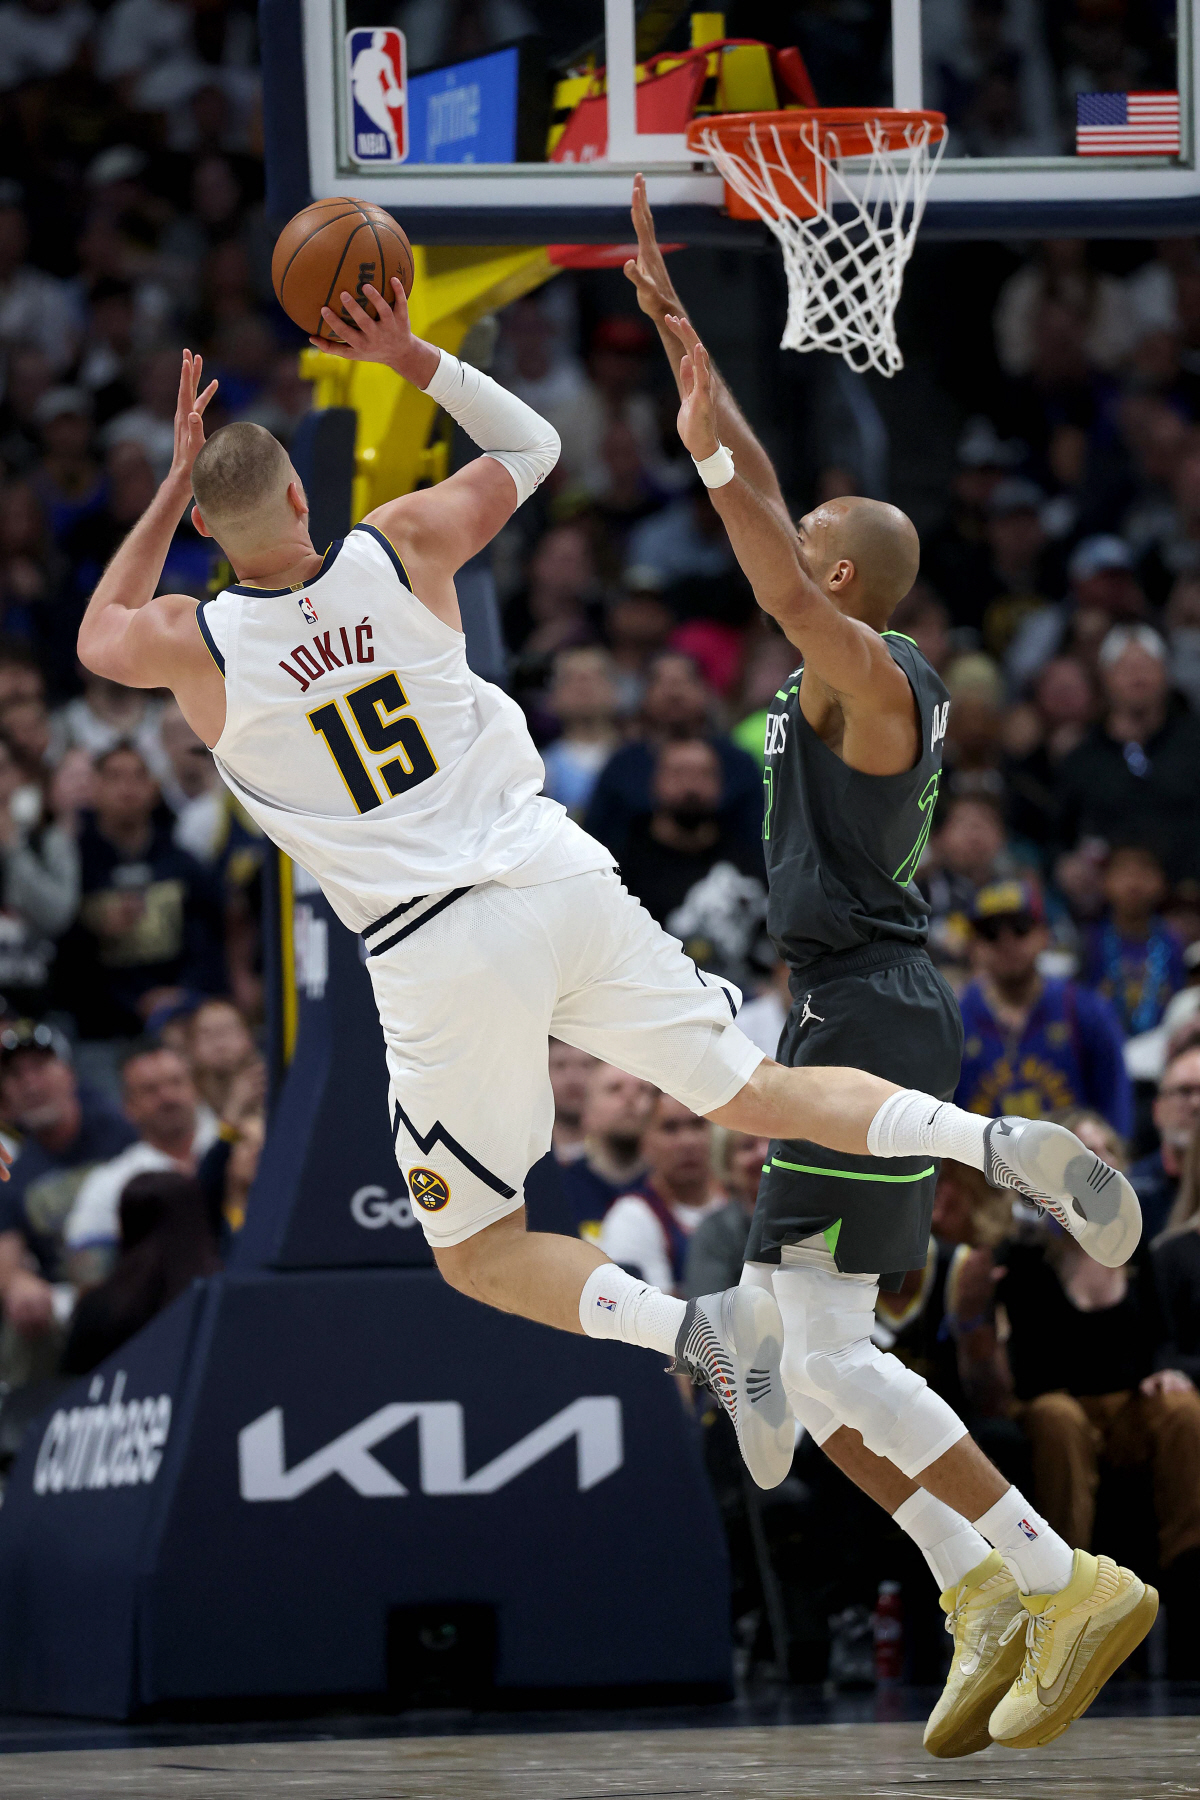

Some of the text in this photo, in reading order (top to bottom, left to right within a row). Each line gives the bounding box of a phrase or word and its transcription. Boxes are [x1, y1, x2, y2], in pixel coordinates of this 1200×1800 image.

[357, 132, 388, 156] NBA
[278, 616, 375, 693] JOKIĆ
[305, 669, 440, 815] 15
[33, 1369, 172, 1496] coinbase
[238, 1395, 624, 1502] KIA
